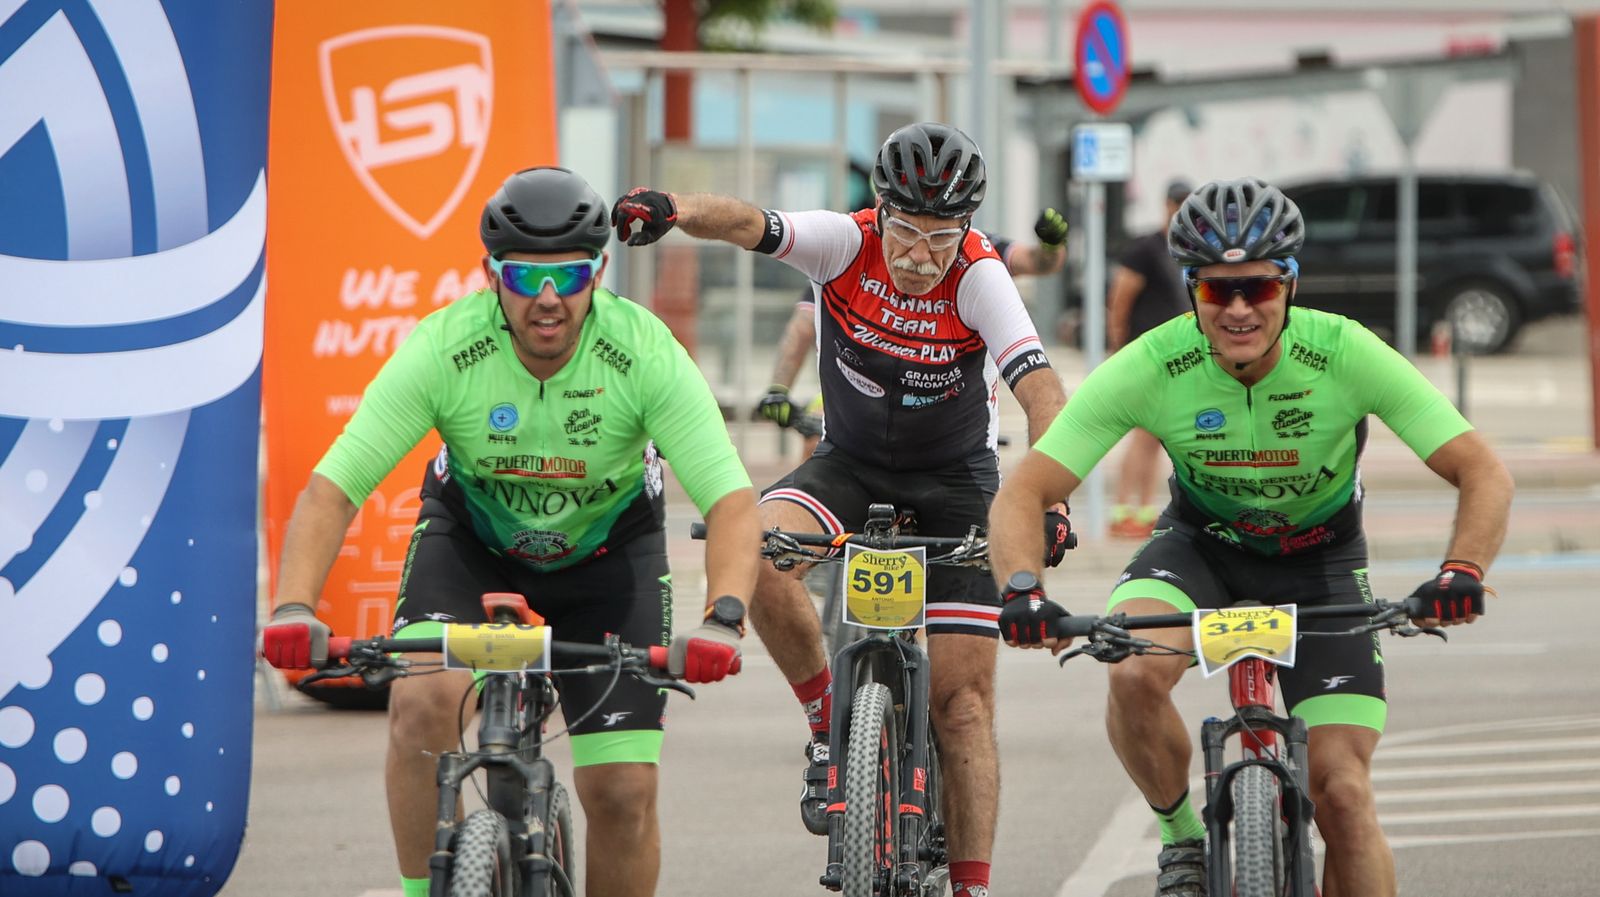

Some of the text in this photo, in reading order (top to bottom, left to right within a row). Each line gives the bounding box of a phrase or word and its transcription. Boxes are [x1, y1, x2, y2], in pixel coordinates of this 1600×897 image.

[341, 266, 419, 310] WE
[881, 308, 937, 335] TEAM
[452, 336, 495, 364] PRADA
[596, 337, 633, 368] PRADA
[853, 324, 917, 357] Winner
[920, 345, 956, 362] PLAY
[1292, 342, 1328, 365] PRADA
[455, 345, 500, 373] FARMA
[592, 345, 630, 377] FARMA
[1166, 347, 1202, 369] PRADA
[1168, 355, 1206, 378] FARMA
[1289, 351, 1327, 373] FARMA
[905, 366, 961, 381] GRAFICAS
[563, 389, 595, 398] FLOWER
[1268, 392, 1304, 401] FLOWER
[496, 455, 587, 473] PUERTOMOTOR
[1206, 450, 1299, 462] PUERTOMOTOR
[862, 553, 907, 568] Sherry
[852, 568, 912, 595] 591
[1206, 618, 1279, 636] 341
